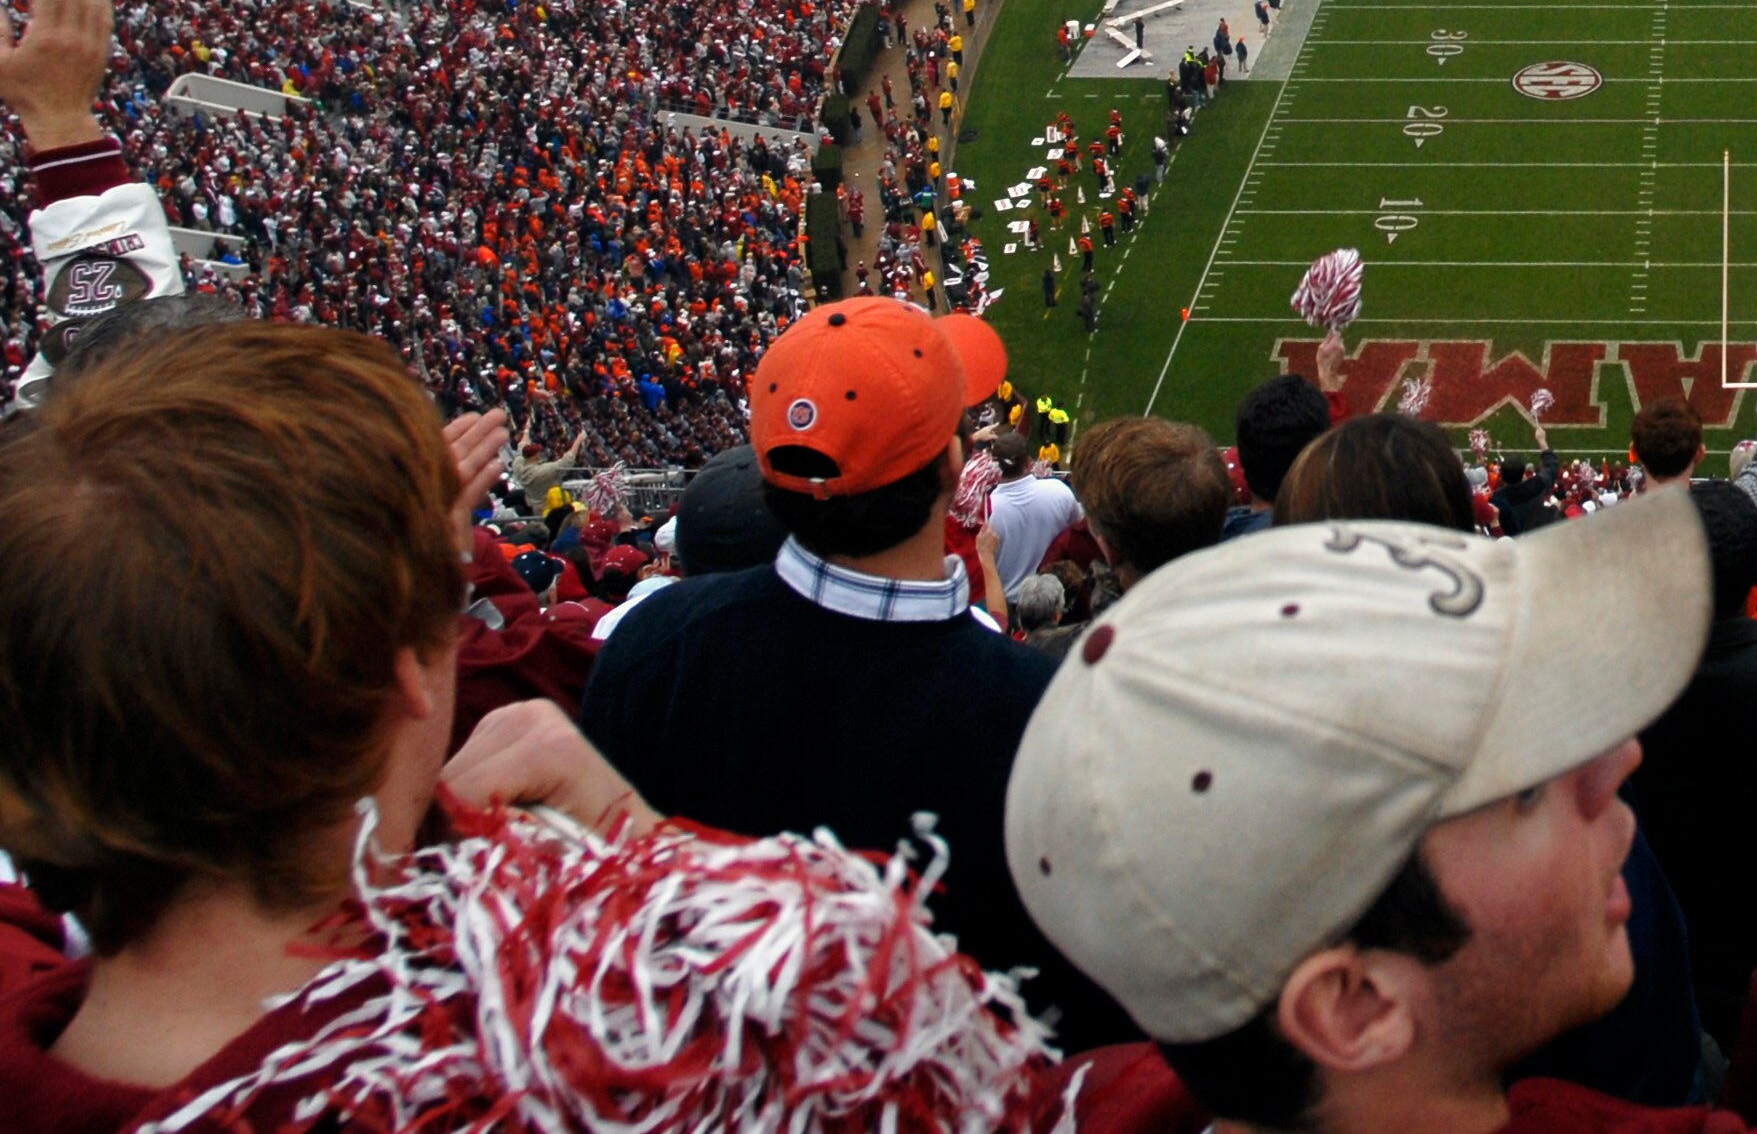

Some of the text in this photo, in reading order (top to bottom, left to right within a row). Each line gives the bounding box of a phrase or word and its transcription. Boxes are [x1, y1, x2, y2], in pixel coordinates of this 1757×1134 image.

[1426, 28, 1468, 56] 30
[1403, 104, 1448, 137] 20
[1374, 197, 1424, 231] 10
